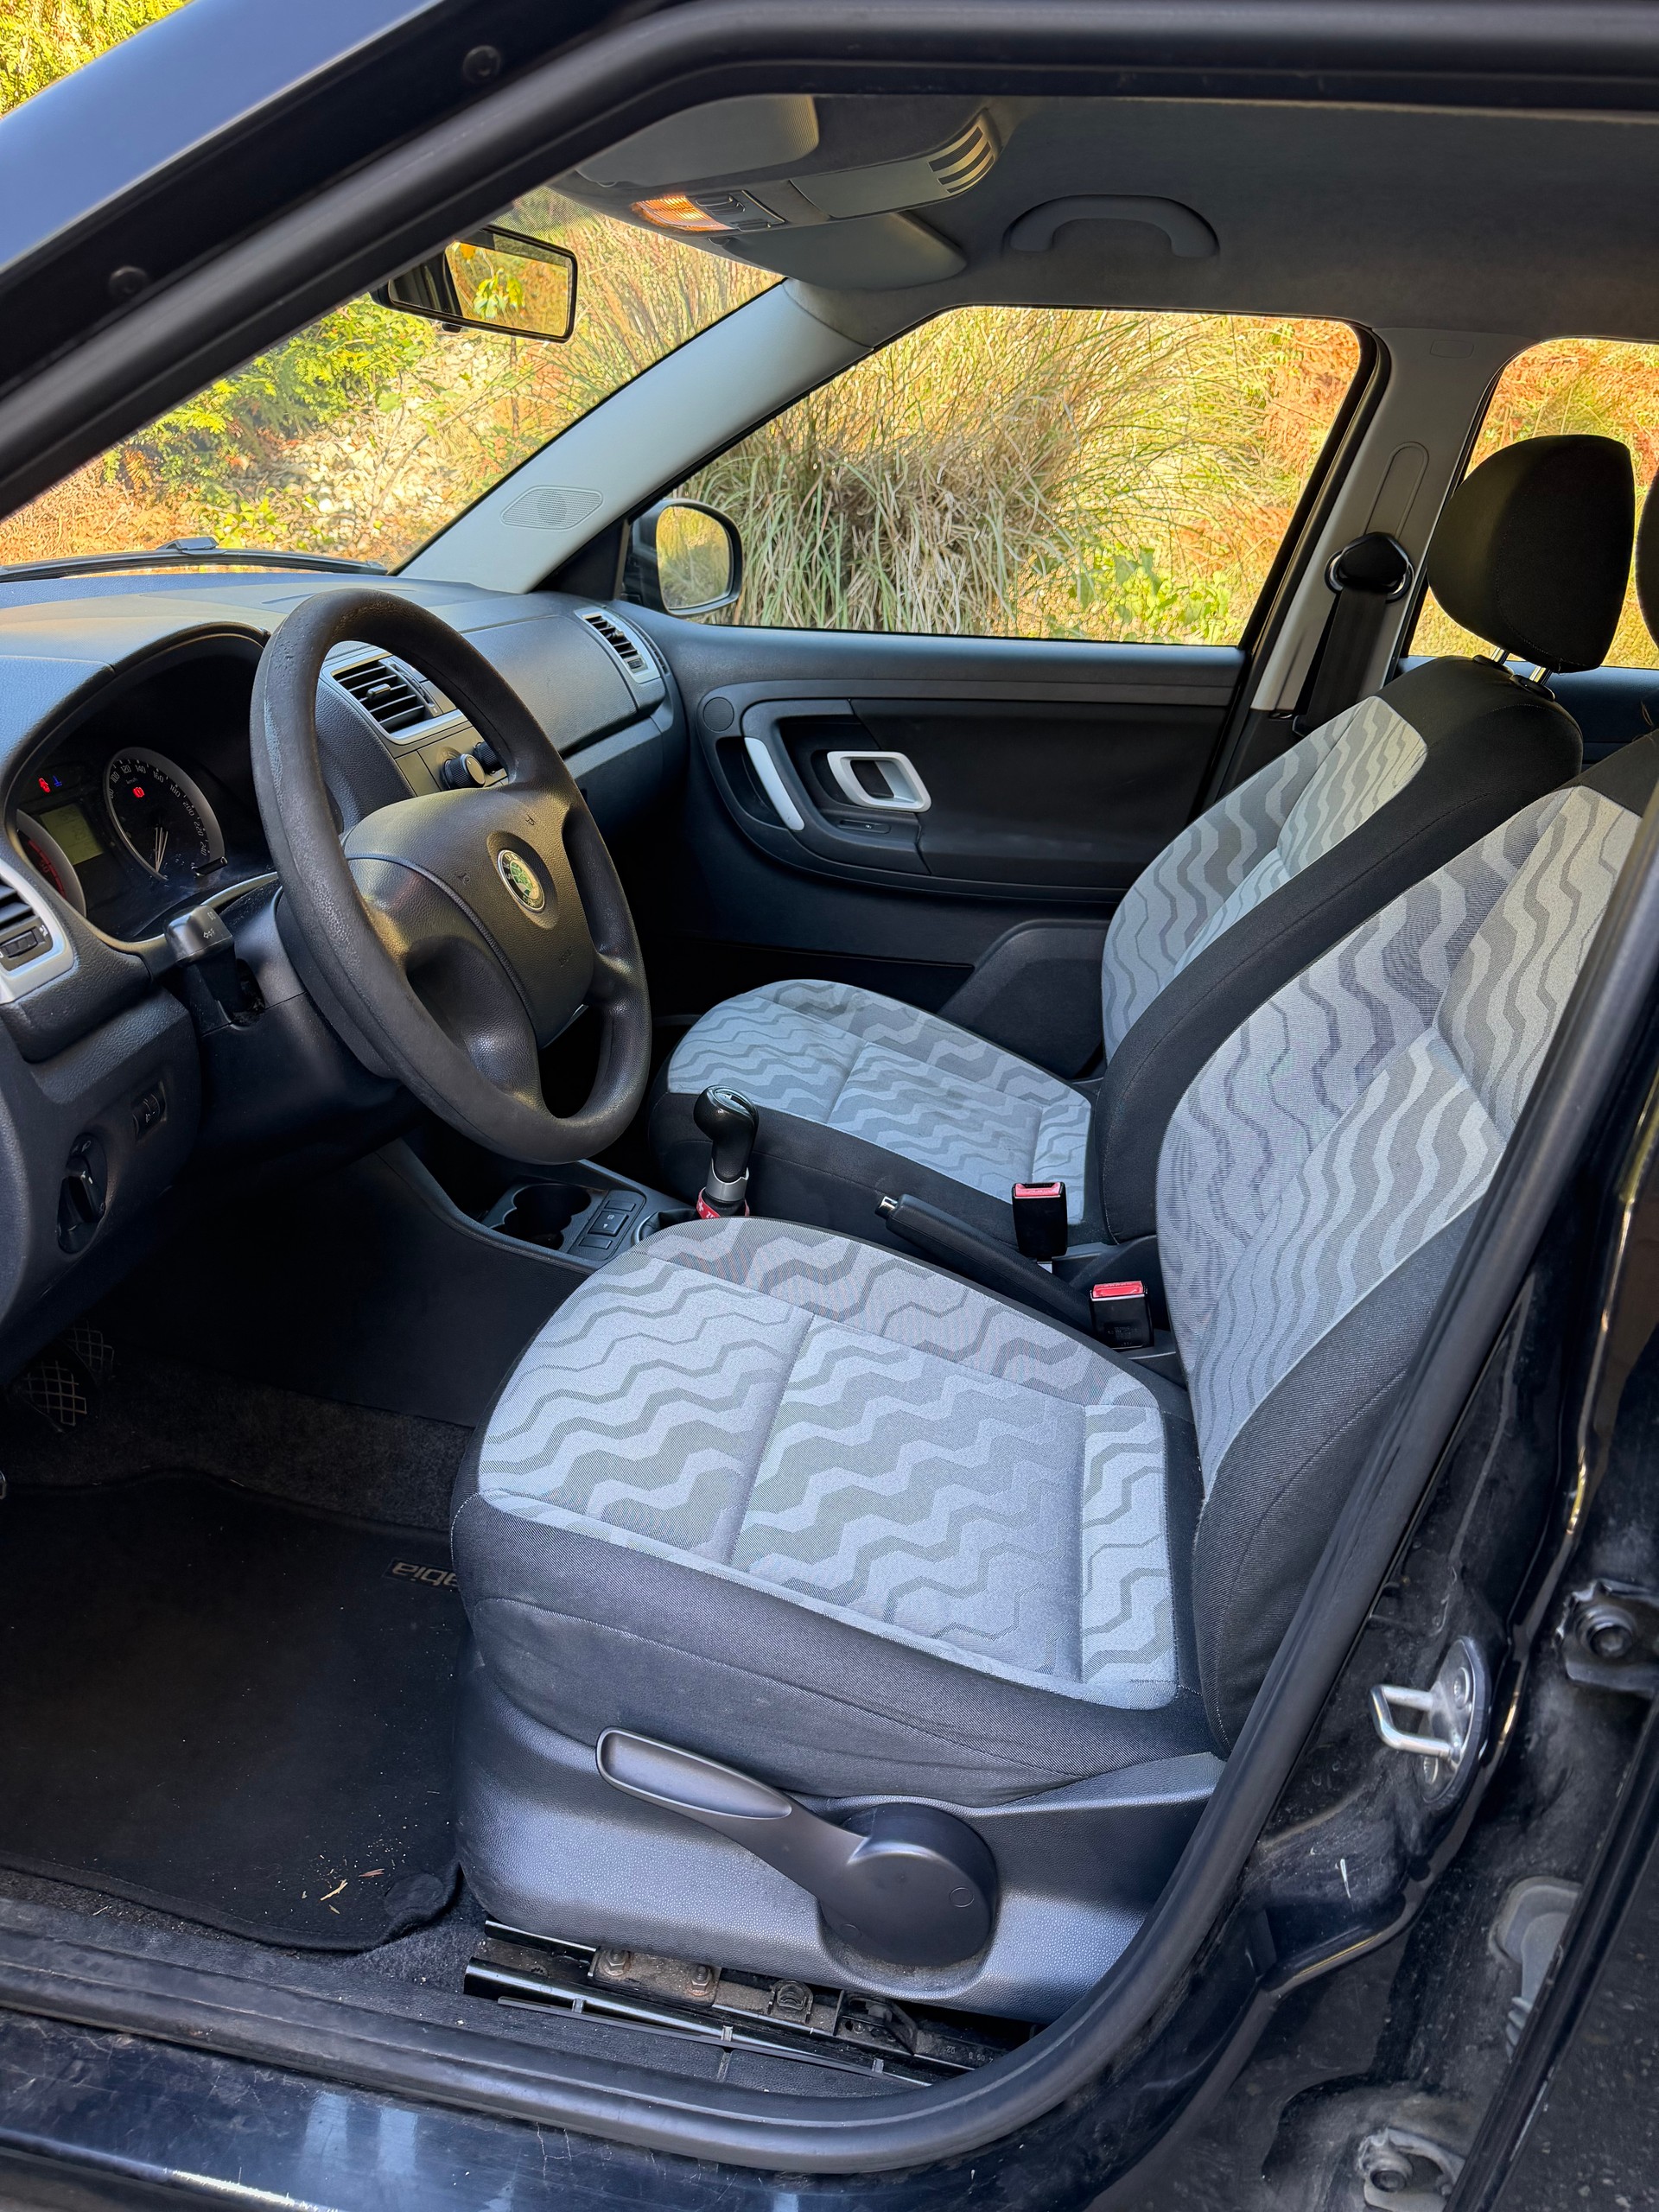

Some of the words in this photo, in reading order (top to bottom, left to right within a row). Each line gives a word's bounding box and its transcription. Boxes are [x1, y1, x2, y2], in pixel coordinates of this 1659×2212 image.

[152, 770, 164, 783] 160
[182, 802, 195, 817] 200
[194, 821, 204, 836] 220
